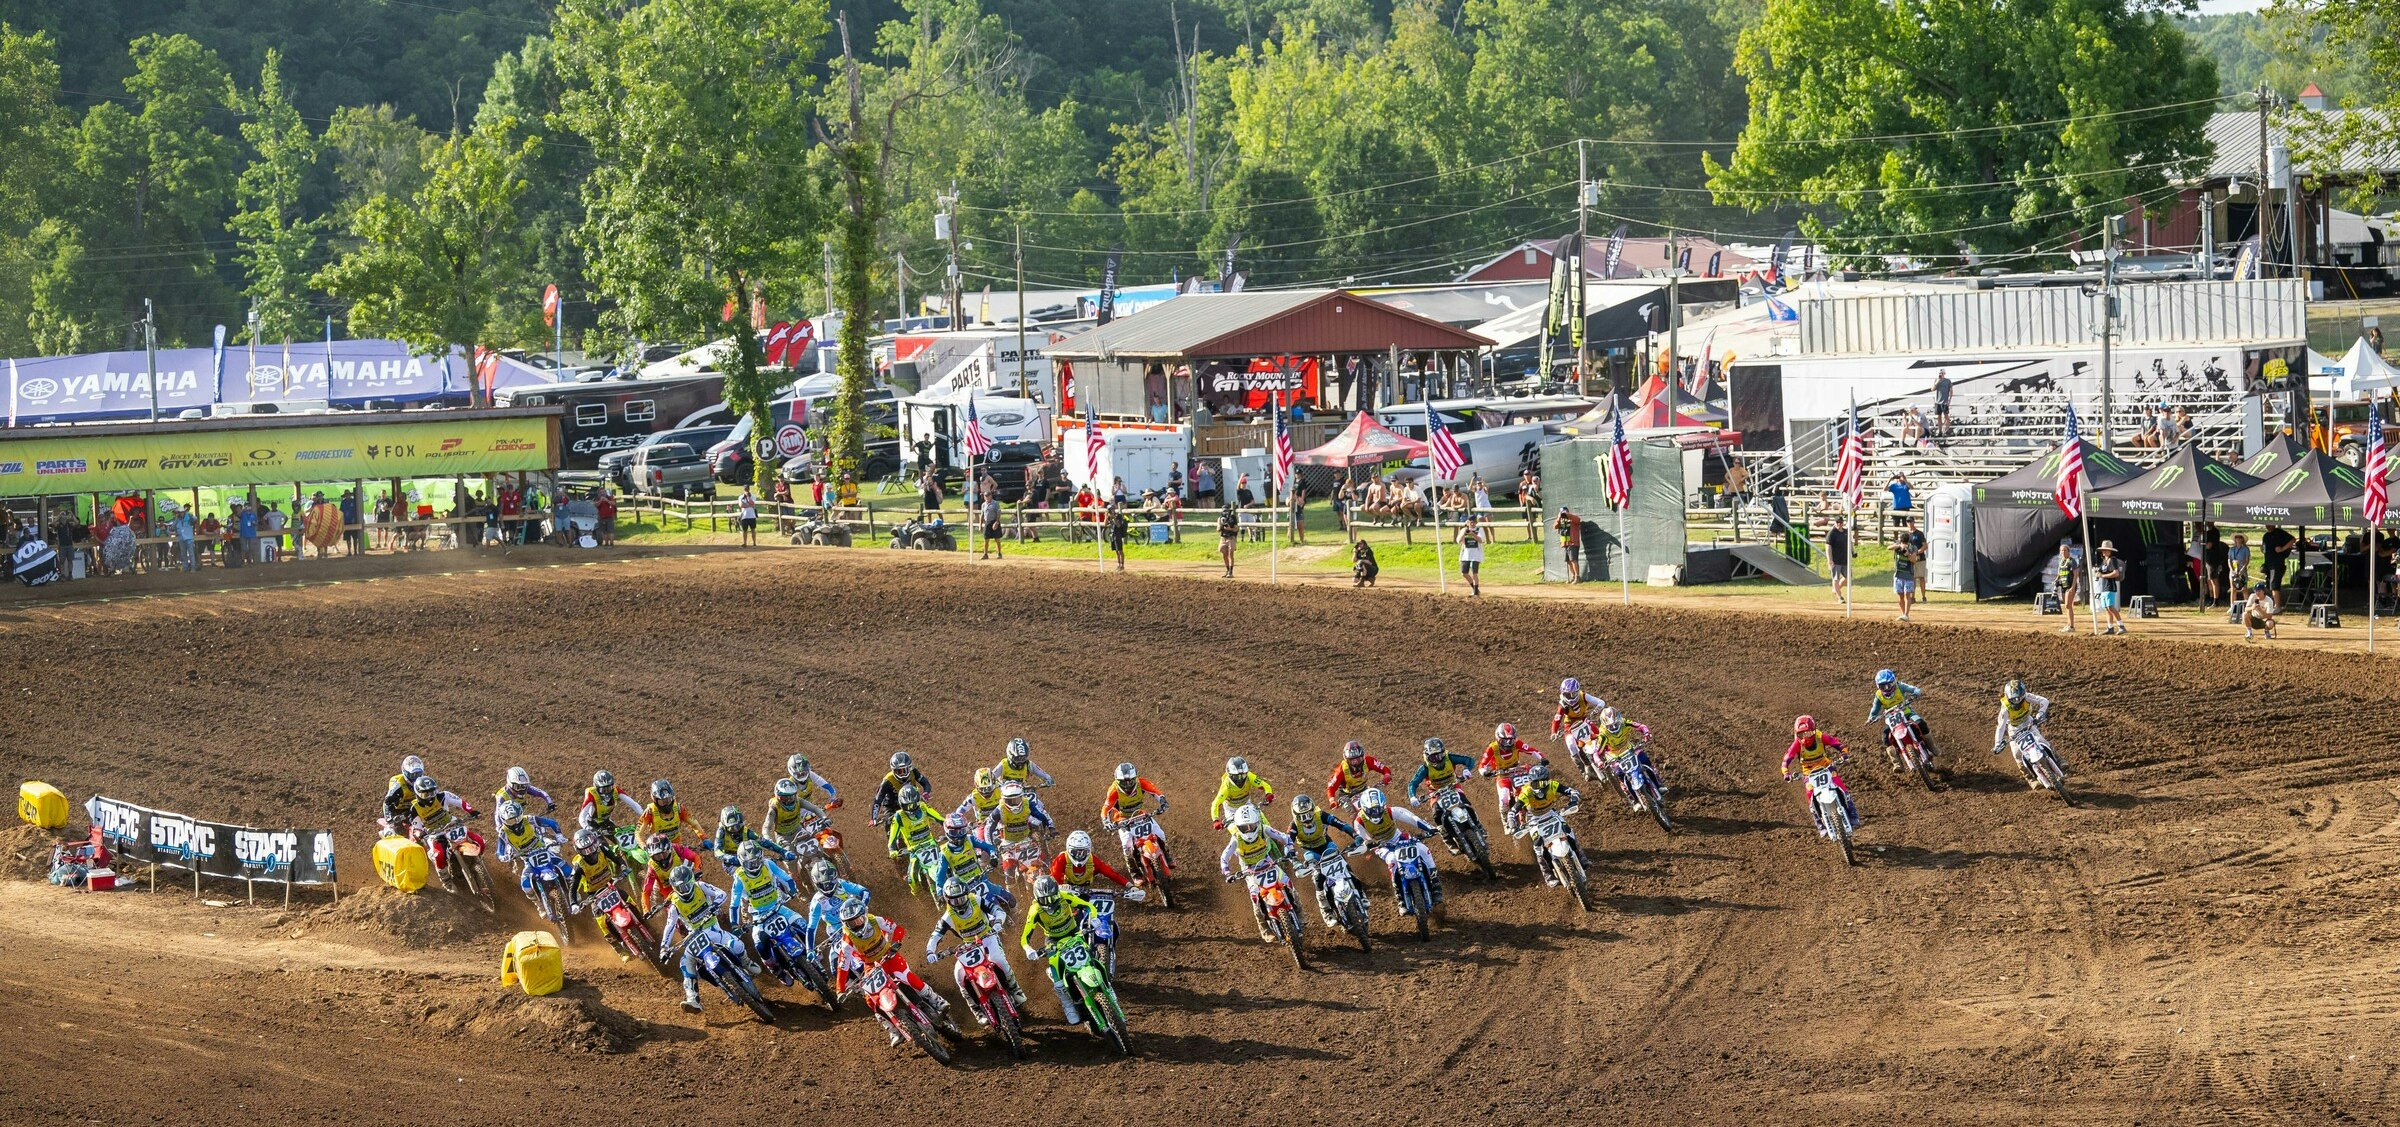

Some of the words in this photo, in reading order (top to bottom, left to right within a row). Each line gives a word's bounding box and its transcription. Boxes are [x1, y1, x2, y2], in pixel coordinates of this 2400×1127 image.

[1101, 270, 1114, 313] TRIUMPH
[1569, 255, 1584, 348] PHOTOS
[289, 359, 424, 385] YAMAHA
[951, 358, 981, 392] PARTS
[1227, 371, 1254, 380] ROCKY
[1255, 371, 1302, 380] MOUNTIN
[61, 370, 198, 394] YAMAHA
[295, 448, 354, 460] PROGRESSIVE
[384, 445, 415, 458] FOX
[425, 450, 476, 459] POLISPORT
[488, 443, 536, 452] LEGENDS
[760, 439, 774, 458] P
[192, 452, 228, 460] MOUNTAIN
[0, 462, 22, 474] OIL
[36, 460, 87, 469] PARTS
[113, 459, 147, 469] THOR
[2011, 490, 2054, 501] MONSTER
[2121, 500, 2165, 511] MONSTER
[2245, 506, 2291, 517] MONSTER
[1576, 727, 1591, 741] 41
[2019, 736, 2035, 751] 29
[1620, 756, 1638, 771] 51
[1814, 774, 1829, 787] 19
[1440, 794, 1460, 809] 66
[151, 816, 216, 855] STACYC
[449, 829, 466, 841] 84
[1135, 825, 1152, 838] 99
[1543, 822, 1561, 838] 31
[620, 833, 636, 848] 27
[801, 840, 820, 855] 23
[533, 852, 550, 867] 12
[921, 849, 939, 864] 21
[1018, 846, 1040, 862] 42
[1397, 846, 1418, 861] 40
[1327, 862, 1344, 877] 44
[1257, 869, 1278, 888] 79
[600, 891, 620, 911] 48
[1092, 900, 1114, 913] 47
[767, 917, 786, 937] 36
[687, 934, 708, 957] 88
[965, 949, 982, 967] 3
[1064, 947, 1088, 968] 33
[866, 973, 887, 994] 73
